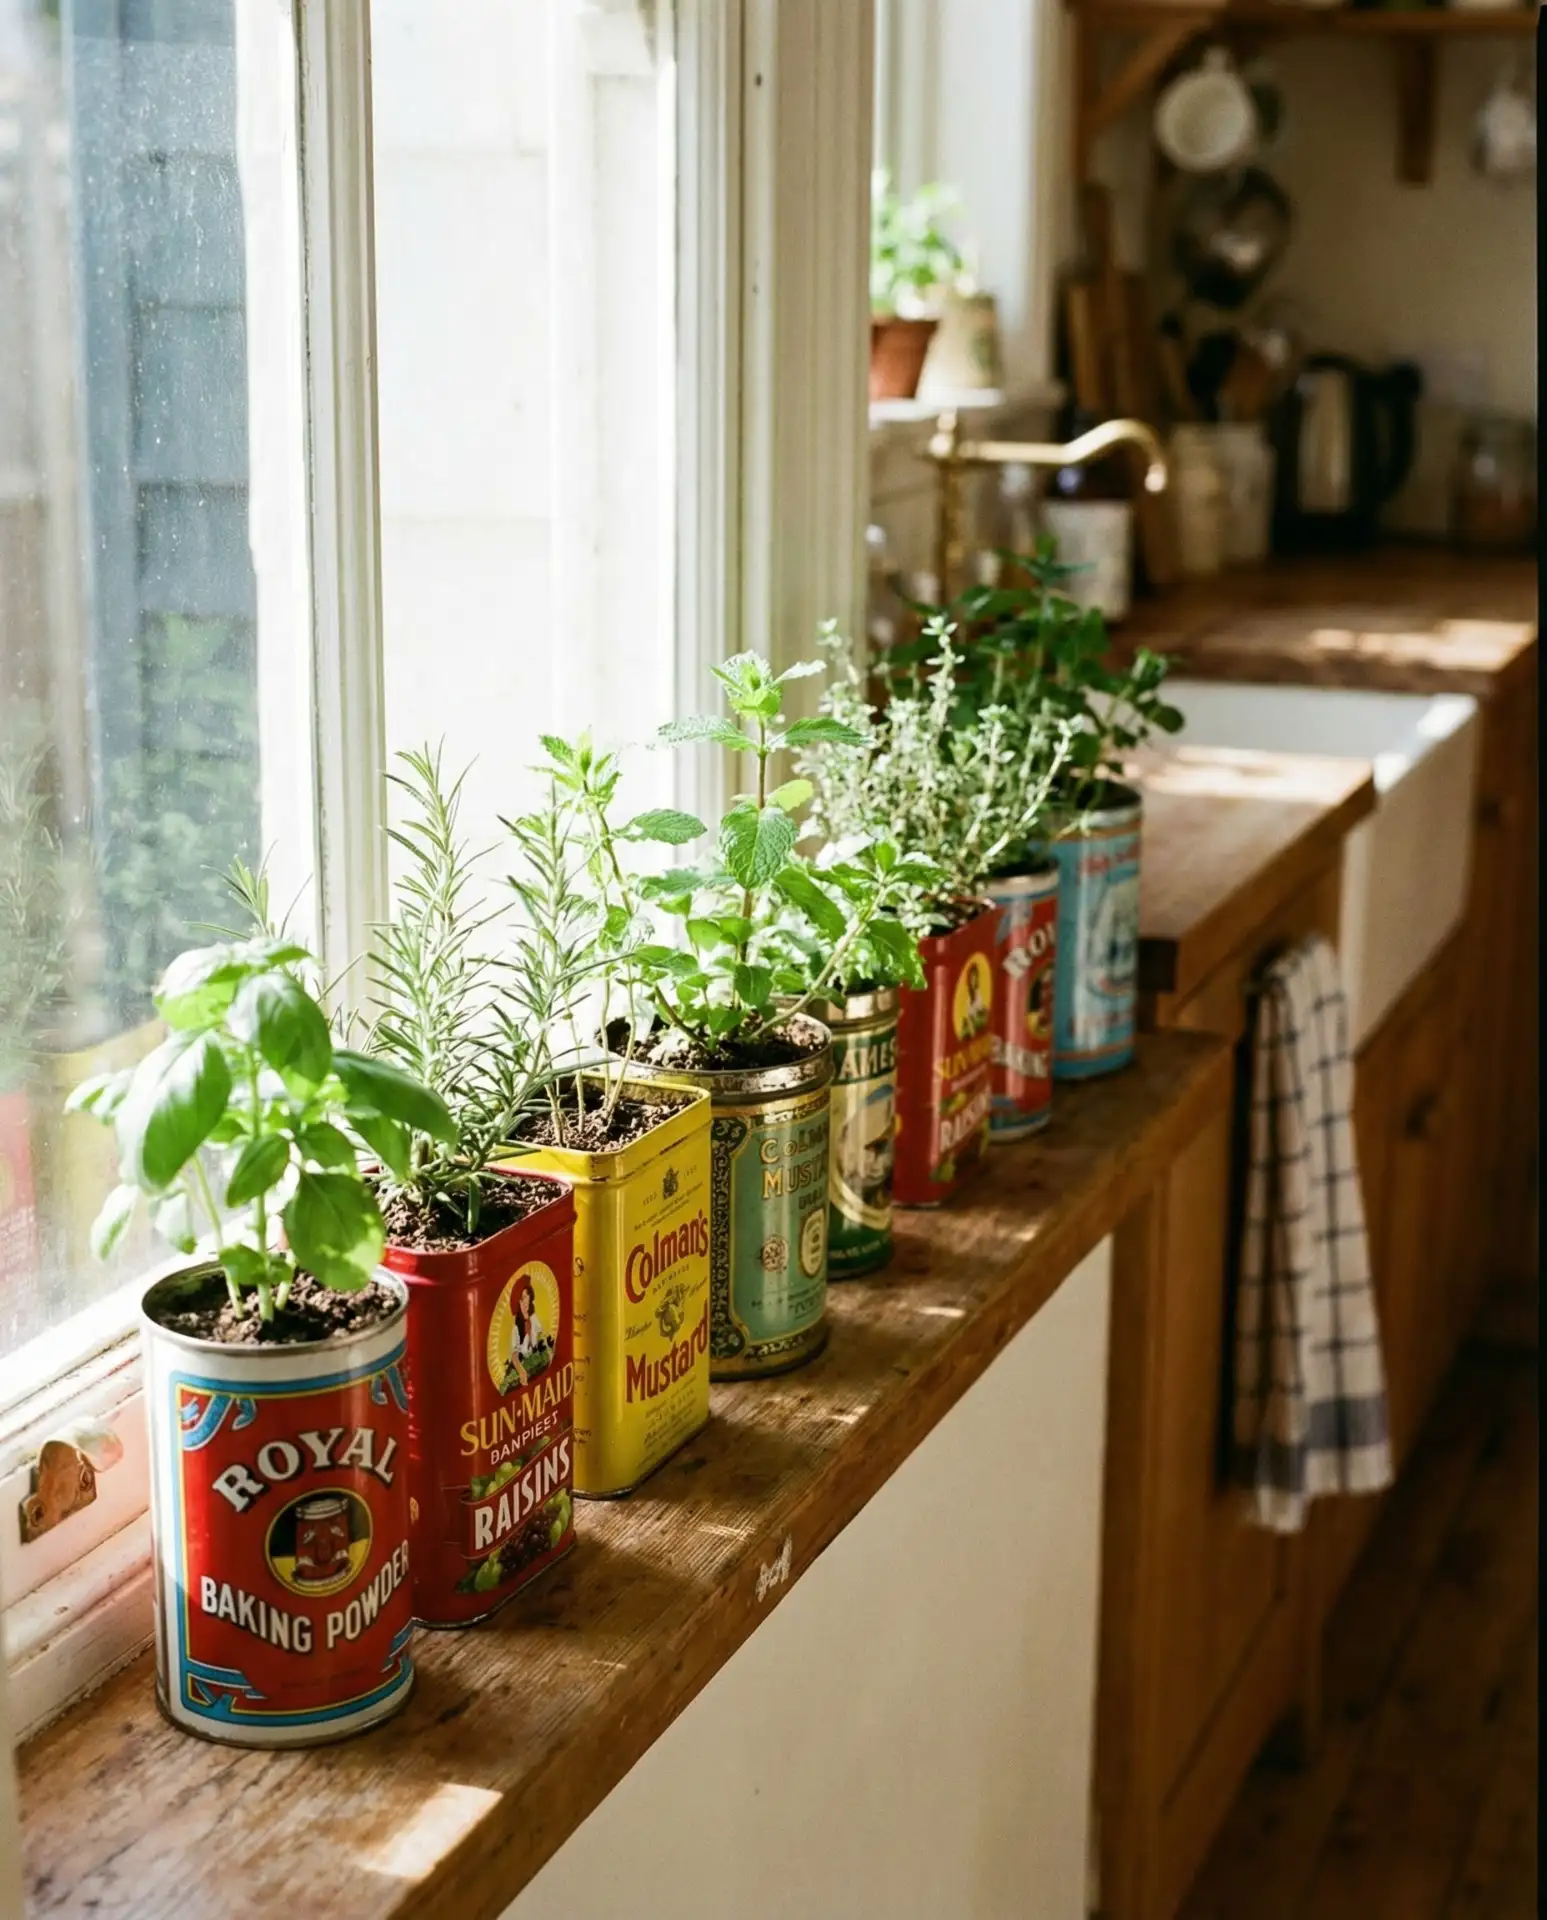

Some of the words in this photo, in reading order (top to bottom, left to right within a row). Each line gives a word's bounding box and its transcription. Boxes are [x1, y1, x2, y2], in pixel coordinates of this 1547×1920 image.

[624, 1208, 709, 1304] Colman's
[625, 1297, 709, 1404] Mustard
[212, 1425, 399, 1513] ROYAL
[474, 1434, 571, 1551] RAISINS
[200, 1575, 312, 1654] BAKING
[326, 1539, 410, 1650] POWDER
